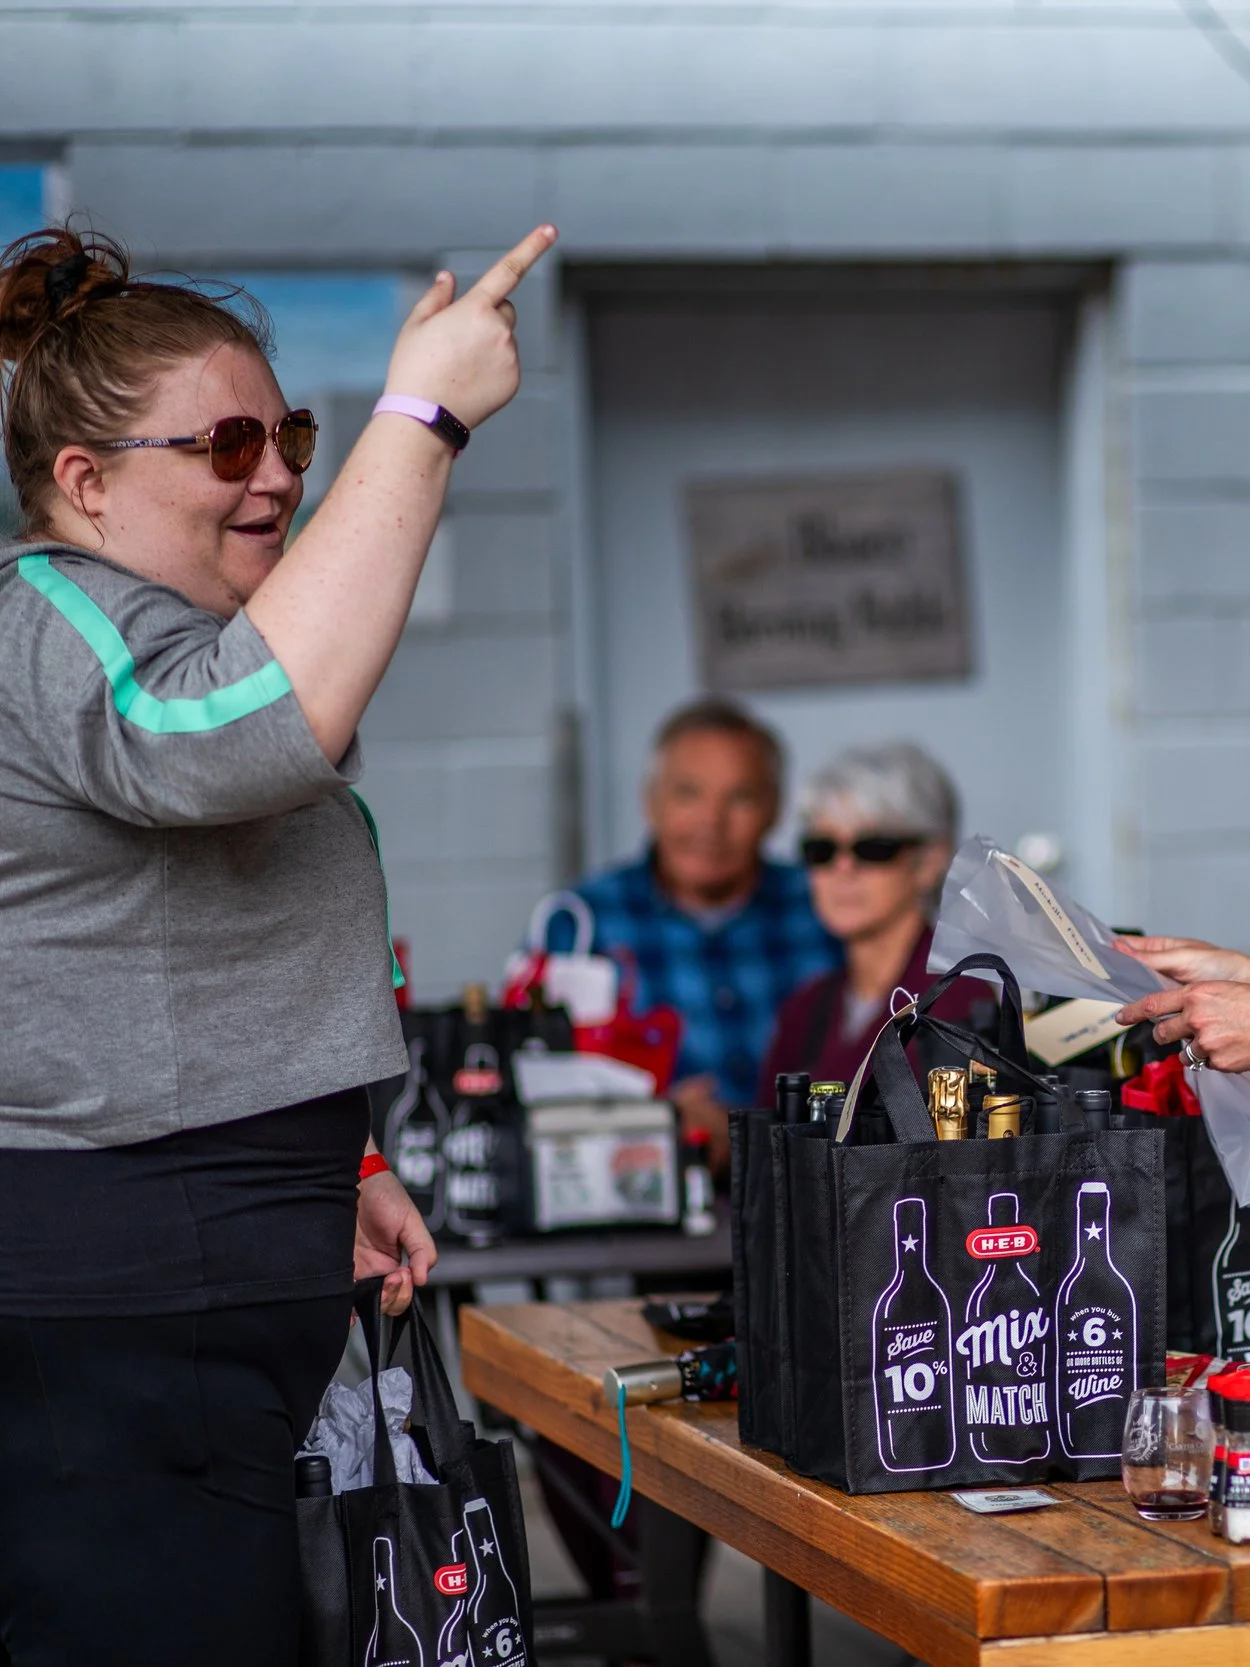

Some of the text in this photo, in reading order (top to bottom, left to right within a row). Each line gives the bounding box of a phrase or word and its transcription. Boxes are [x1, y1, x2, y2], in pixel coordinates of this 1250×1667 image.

[1070, 1306, 1121, 1322] when you buy
[887, 1329, 935, 1361] Save
[956, 1307, 1050, 1368] Mix
[1083, 1317, 1107, 1347] 6
[1016, 1352, 1037, 1377] &
[1074, 1356, 1091, 1366] MORE
[1091, 1356, 1115, 1366] BOTTLES
[1115, 1355, 1123, 1365] OF
[884, 1360, 949, 1403] 10%
[1068, 1374, 1123, 1400] Wine
[965, 1382, 1049, 1426] MATCH
[482, 1621, 499, 1638] when
[498, 1617, 510, 1627] you
[495, 1627, 513, 1658] 6
